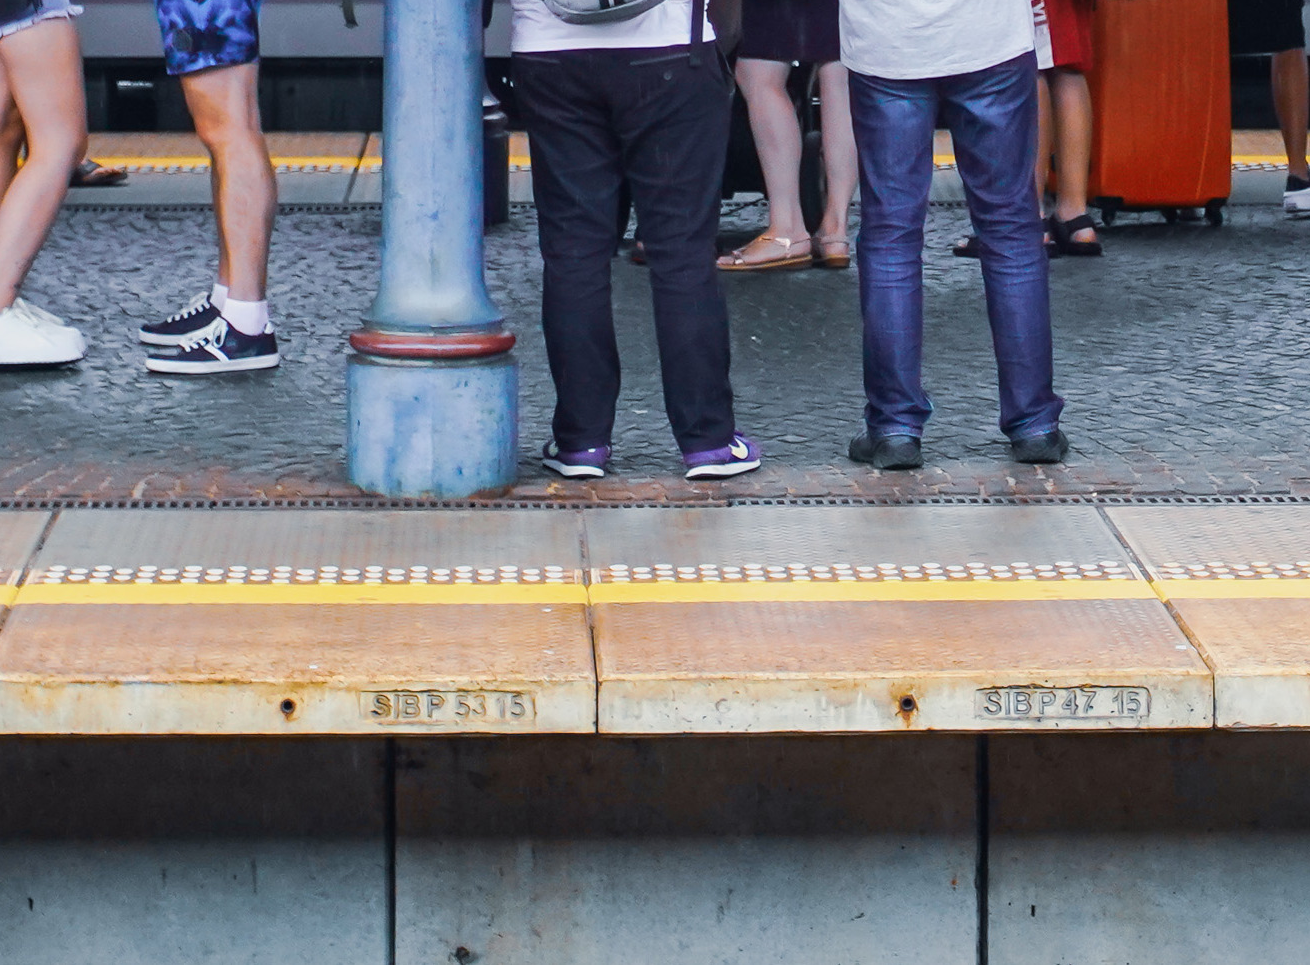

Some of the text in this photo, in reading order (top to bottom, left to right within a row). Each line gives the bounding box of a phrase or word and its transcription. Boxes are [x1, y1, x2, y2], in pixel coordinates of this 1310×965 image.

[496, 693, 526, 719] 15
[1061, 689, 1097, 715] 47
[1111, 690, 1142, 715] 15
